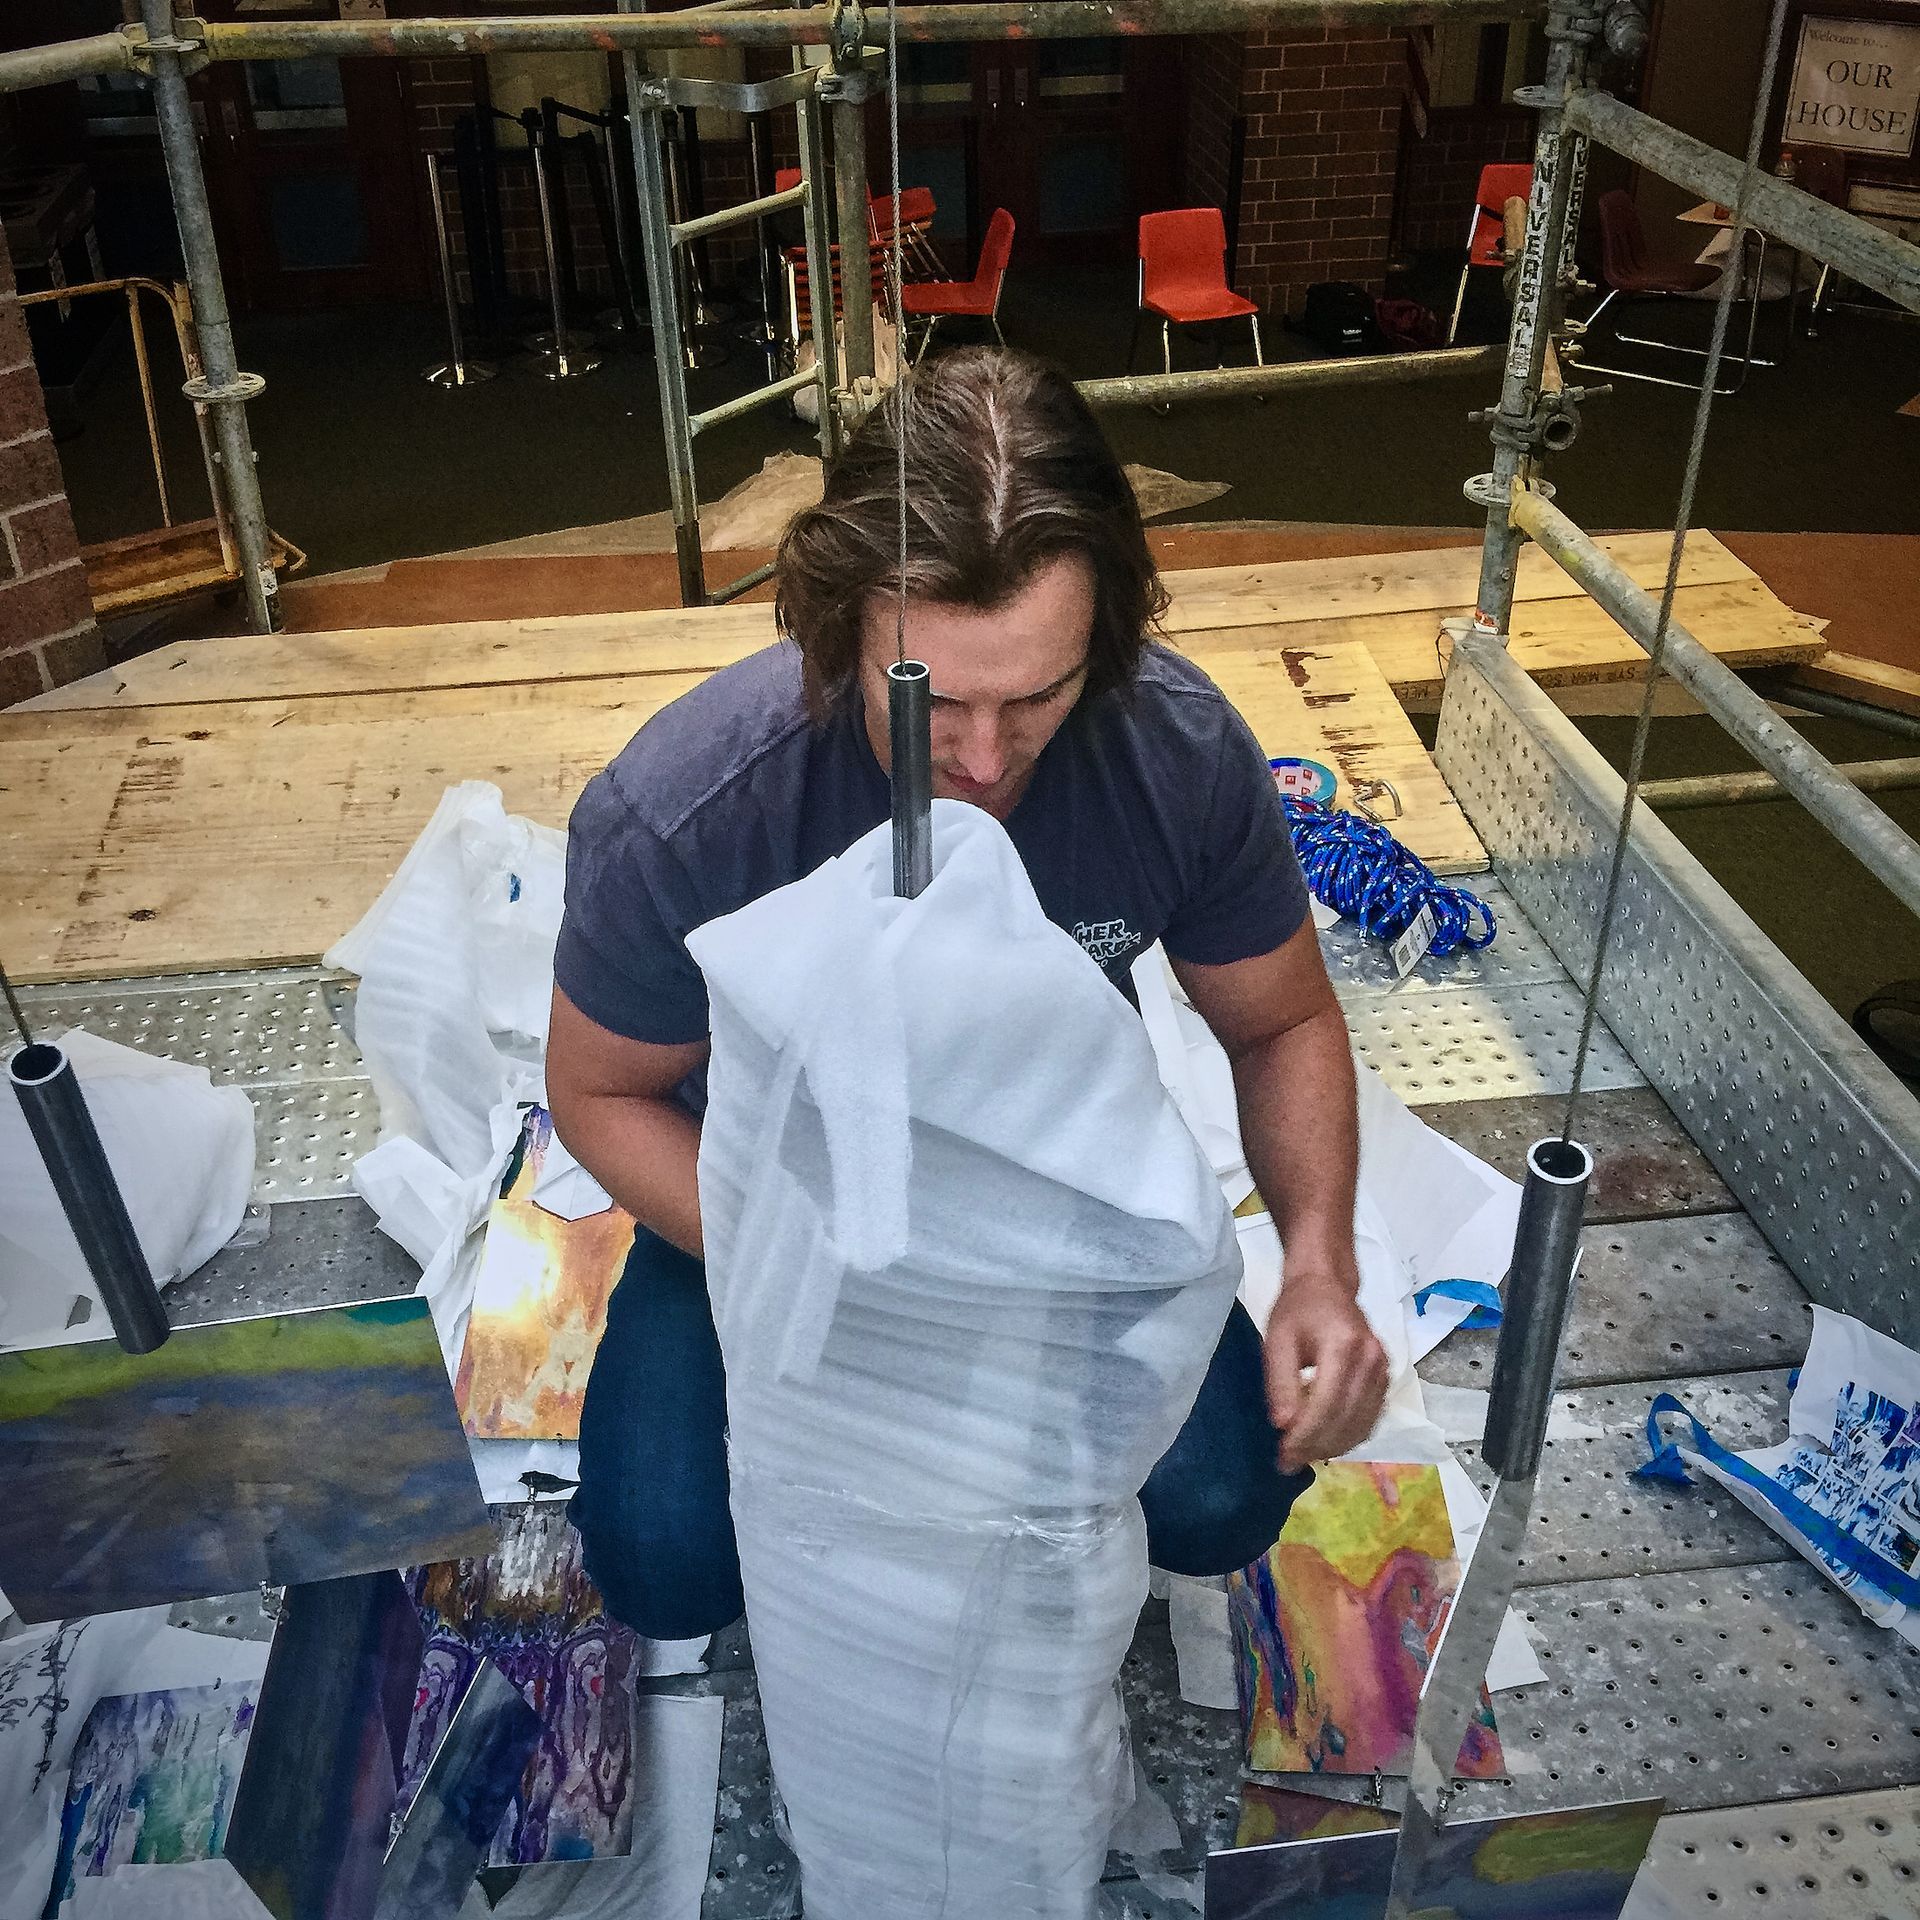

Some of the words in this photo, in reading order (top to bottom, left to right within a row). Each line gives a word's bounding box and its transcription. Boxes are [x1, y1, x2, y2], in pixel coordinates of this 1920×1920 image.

[1809, 29, 1860, 46] Welcome
[1826, 59, 1893, 89] OUR
[1797, 100, 1908, 135] HOUSE
